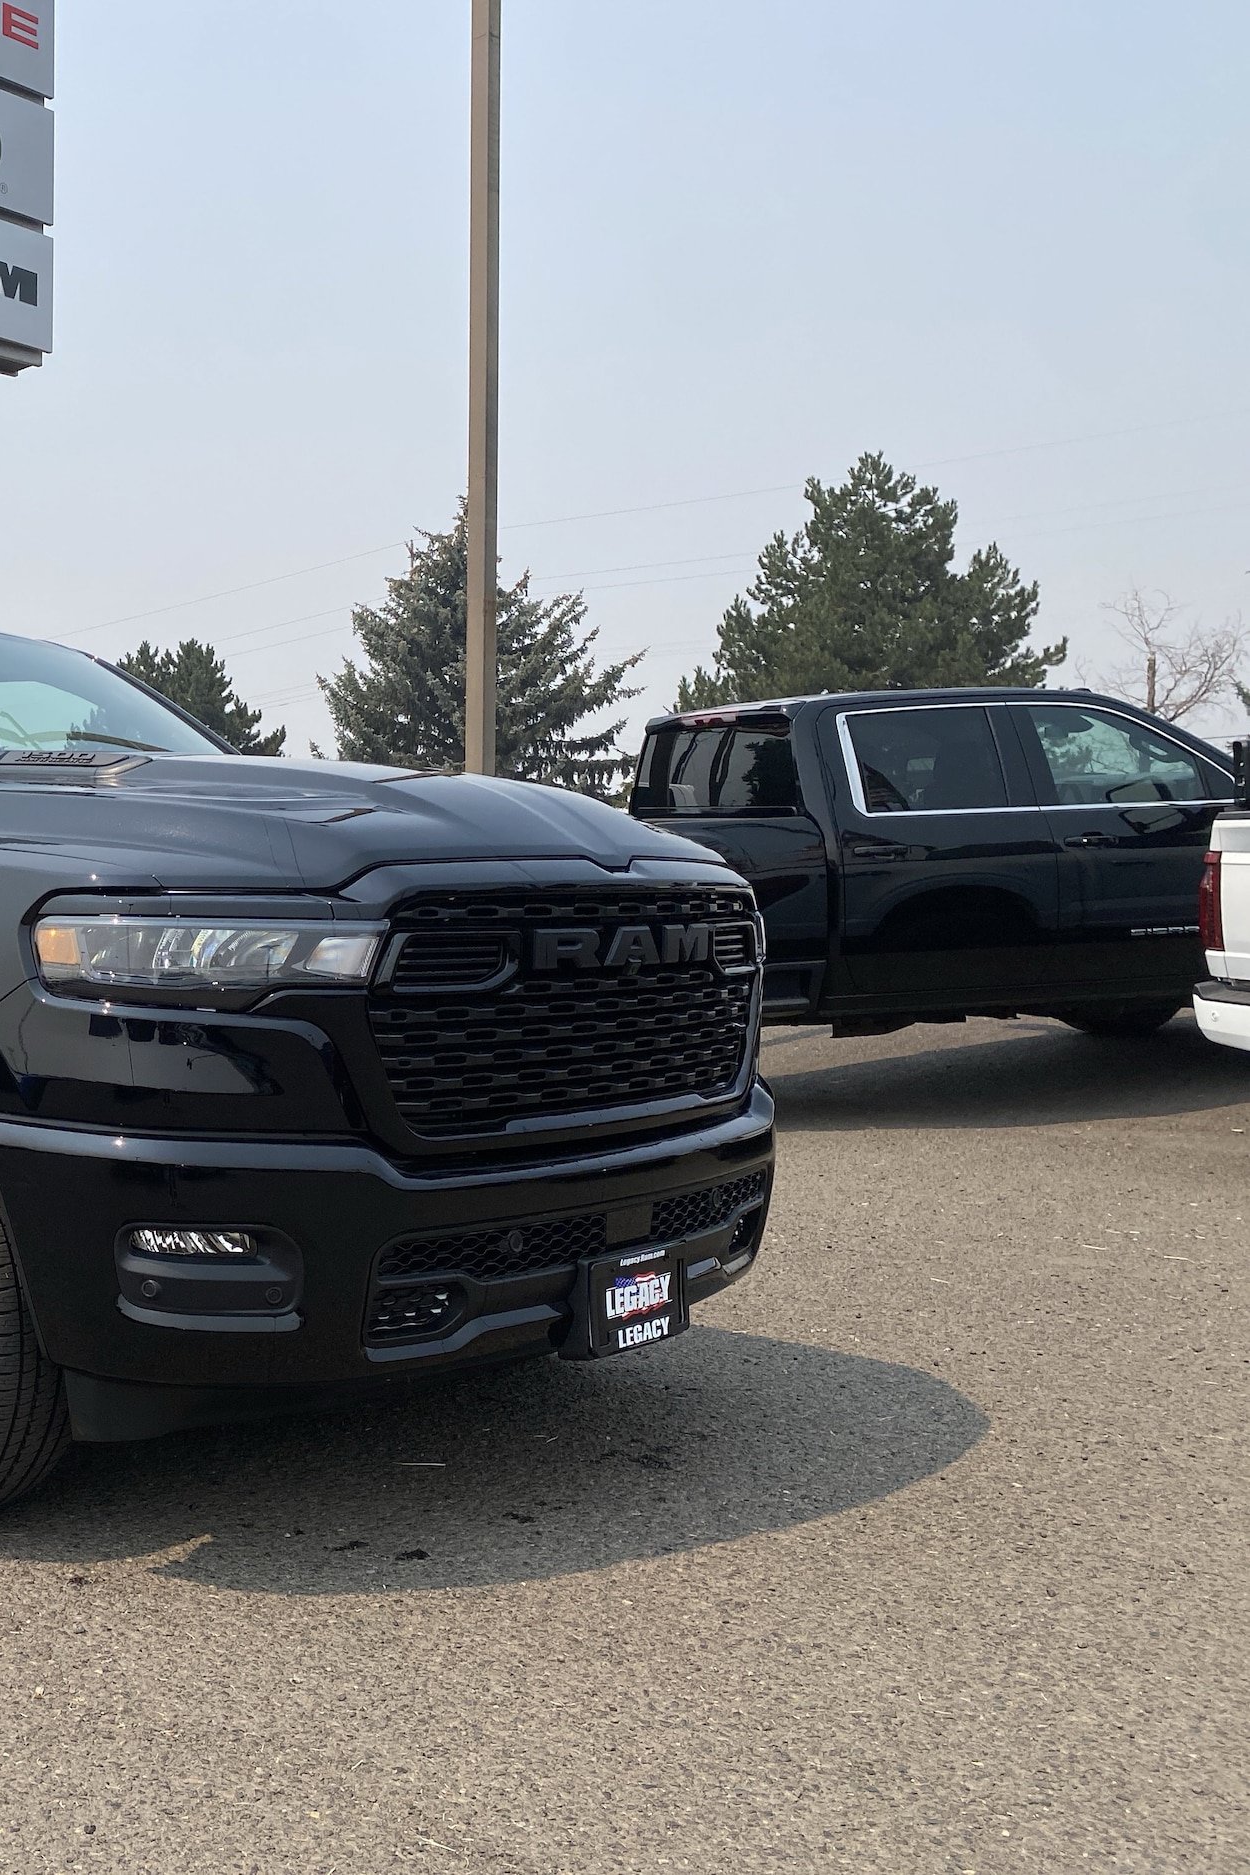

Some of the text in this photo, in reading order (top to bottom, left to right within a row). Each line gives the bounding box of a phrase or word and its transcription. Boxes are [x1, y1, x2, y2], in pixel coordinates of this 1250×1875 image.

[534, 923, 710, 970] RAM
[1130, 926, 1200, 936] SIERR
[606, 1274, 671, 1317] LEGACY
[617, 1316, 670, 1349] LEGACY
